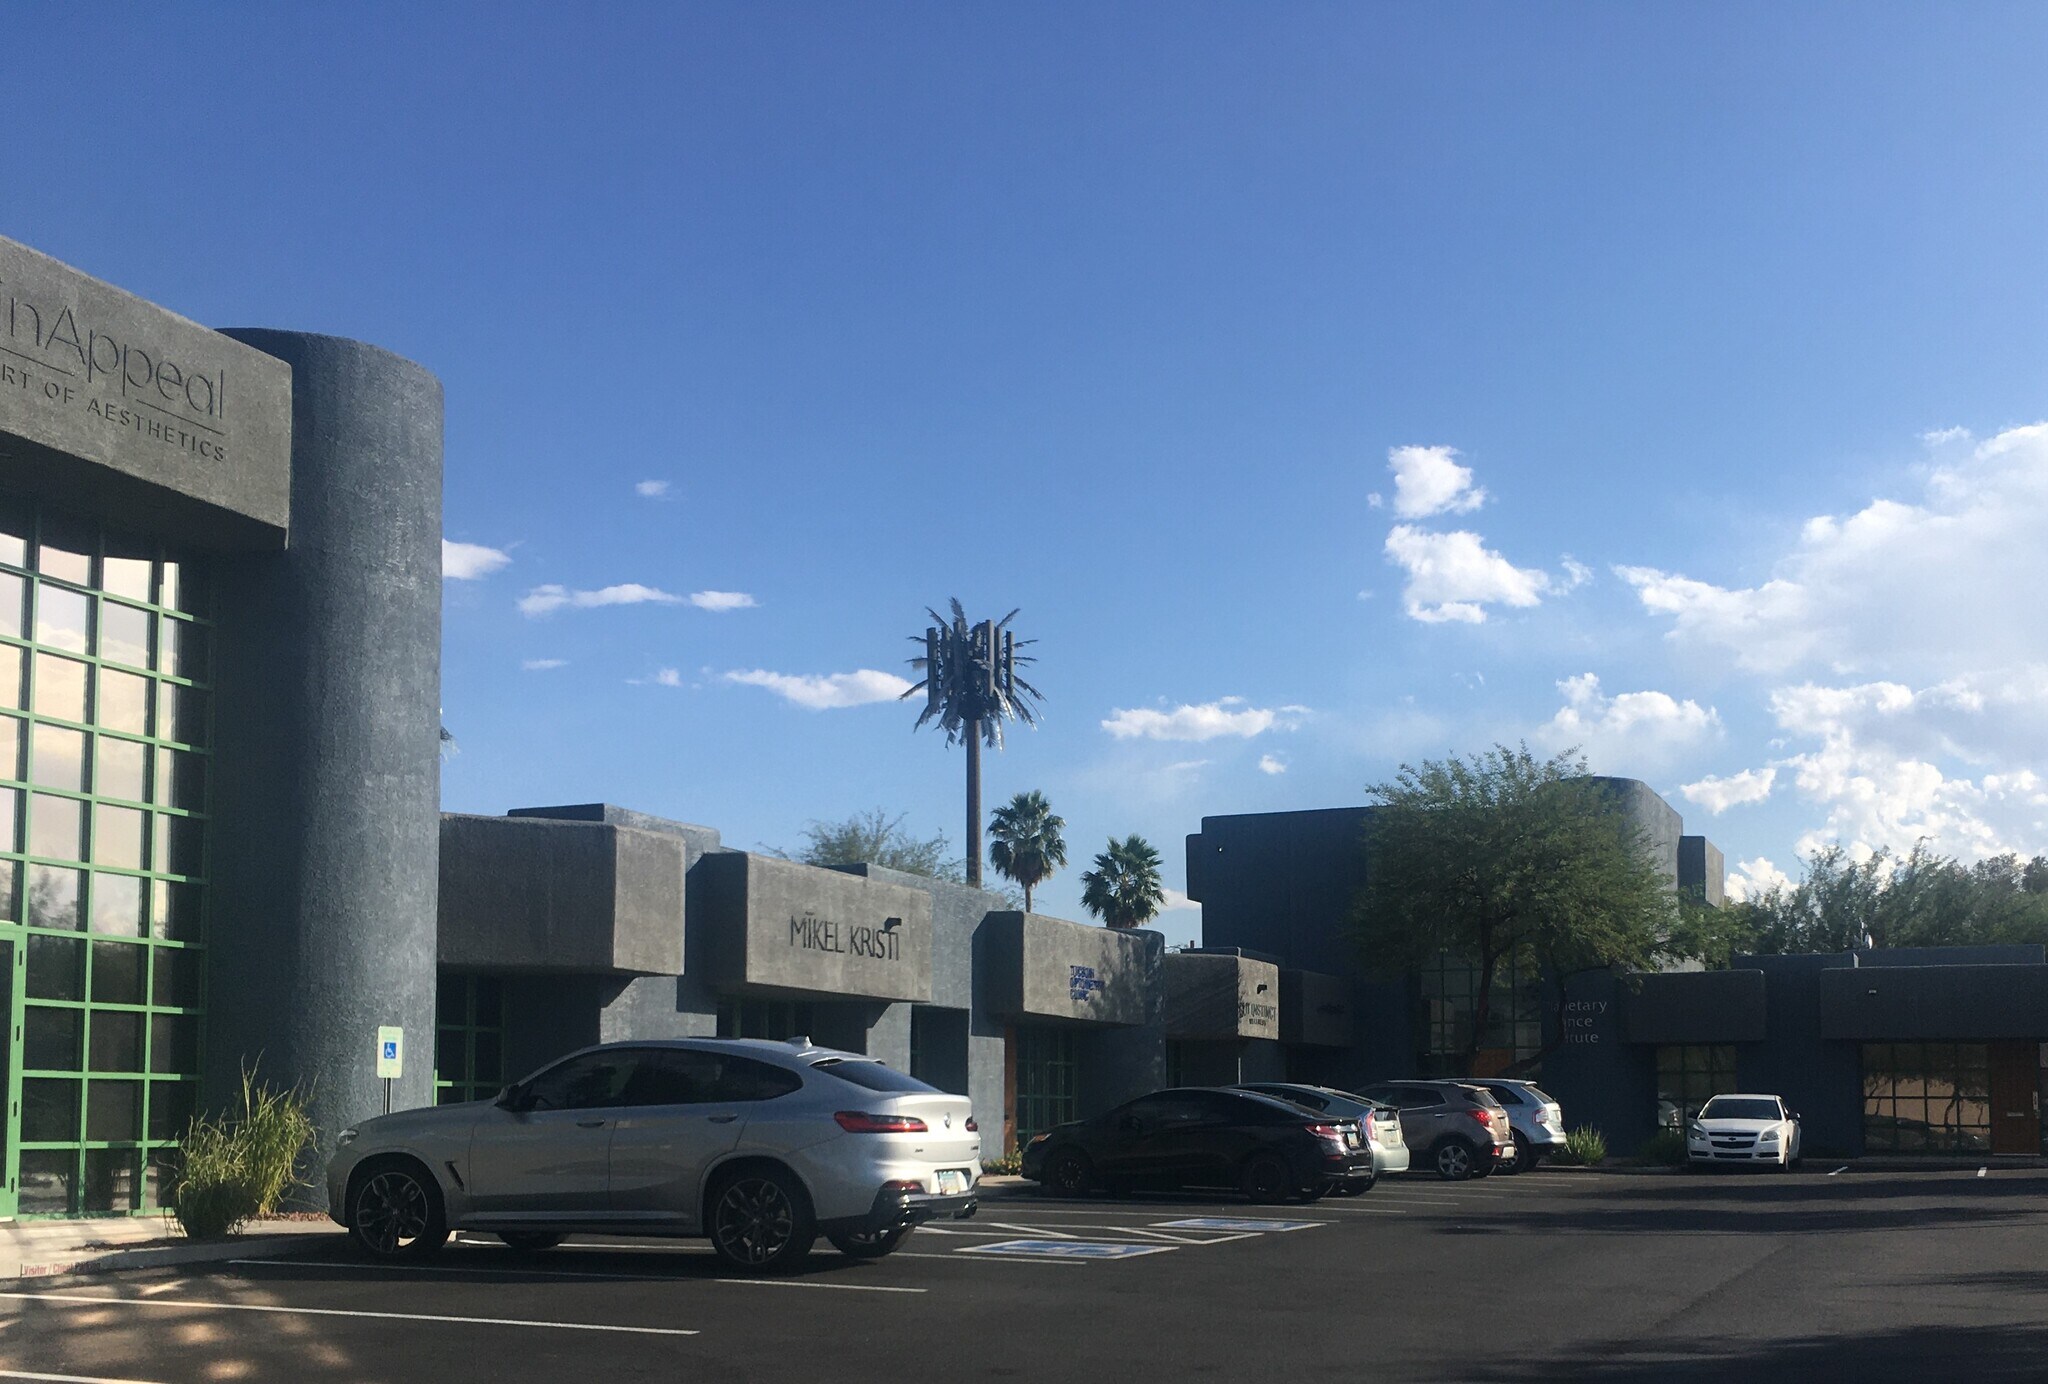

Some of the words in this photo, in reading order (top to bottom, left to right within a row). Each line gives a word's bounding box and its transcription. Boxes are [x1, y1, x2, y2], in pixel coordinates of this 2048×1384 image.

[4, 295, 225, 420] nAppeal
[44, 382, 75, 404] OF
[87, 398, 224, 462] AESTHETICS
[849, 925, 900, 961] KRISTI
